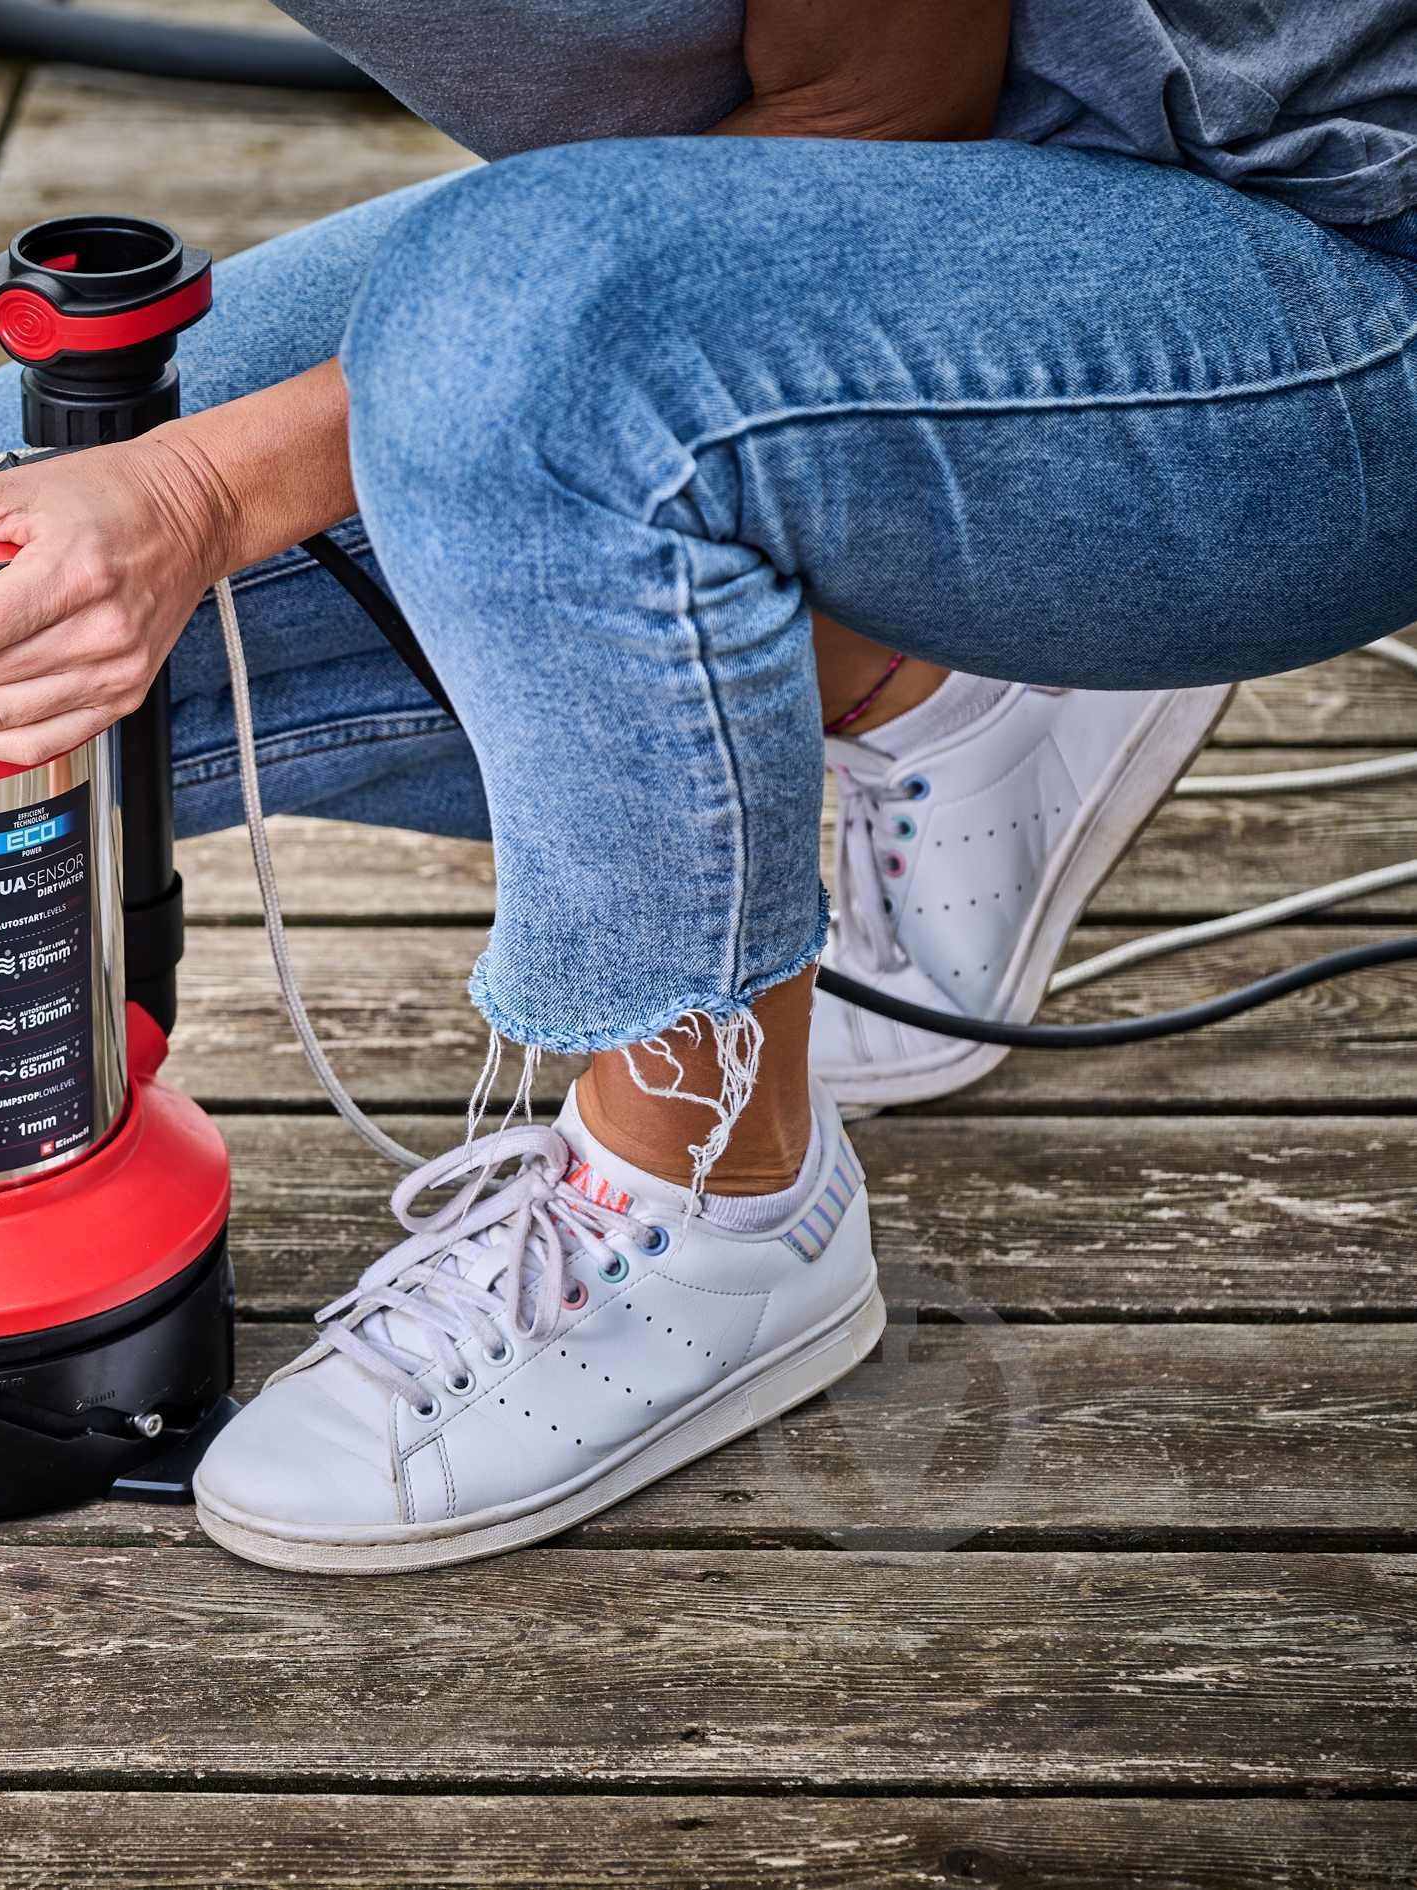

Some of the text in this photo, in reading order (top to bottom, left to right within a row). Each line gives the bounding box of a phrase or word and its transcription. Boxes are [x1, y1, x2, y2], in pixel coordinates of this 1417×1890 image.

[13, 813, 50, 828] TECHNOLOGY
[18, 807, 46, 820] EFFICIENT
[6, 821, 56, 851] ECO
[21, 846, 42, 857] POWER
[37, 871, 84, 898] DIRTWATER
[18, 939, 67, 959] AUTOSTART LEVEL
[19, 945, 71, 972] 180mm
[19, 996, 67, 1017] AUTOSTART LEVEL
[19, 1002, 72, 1030] 130mm
[20, 1045, 68, 1065] AUTOSTART LEVEL
[19, 1056, 66, 1080] 65mm
[18, 1116, 57, 1136] 1mm
[55, 1126, 89, 1149] Einhell
